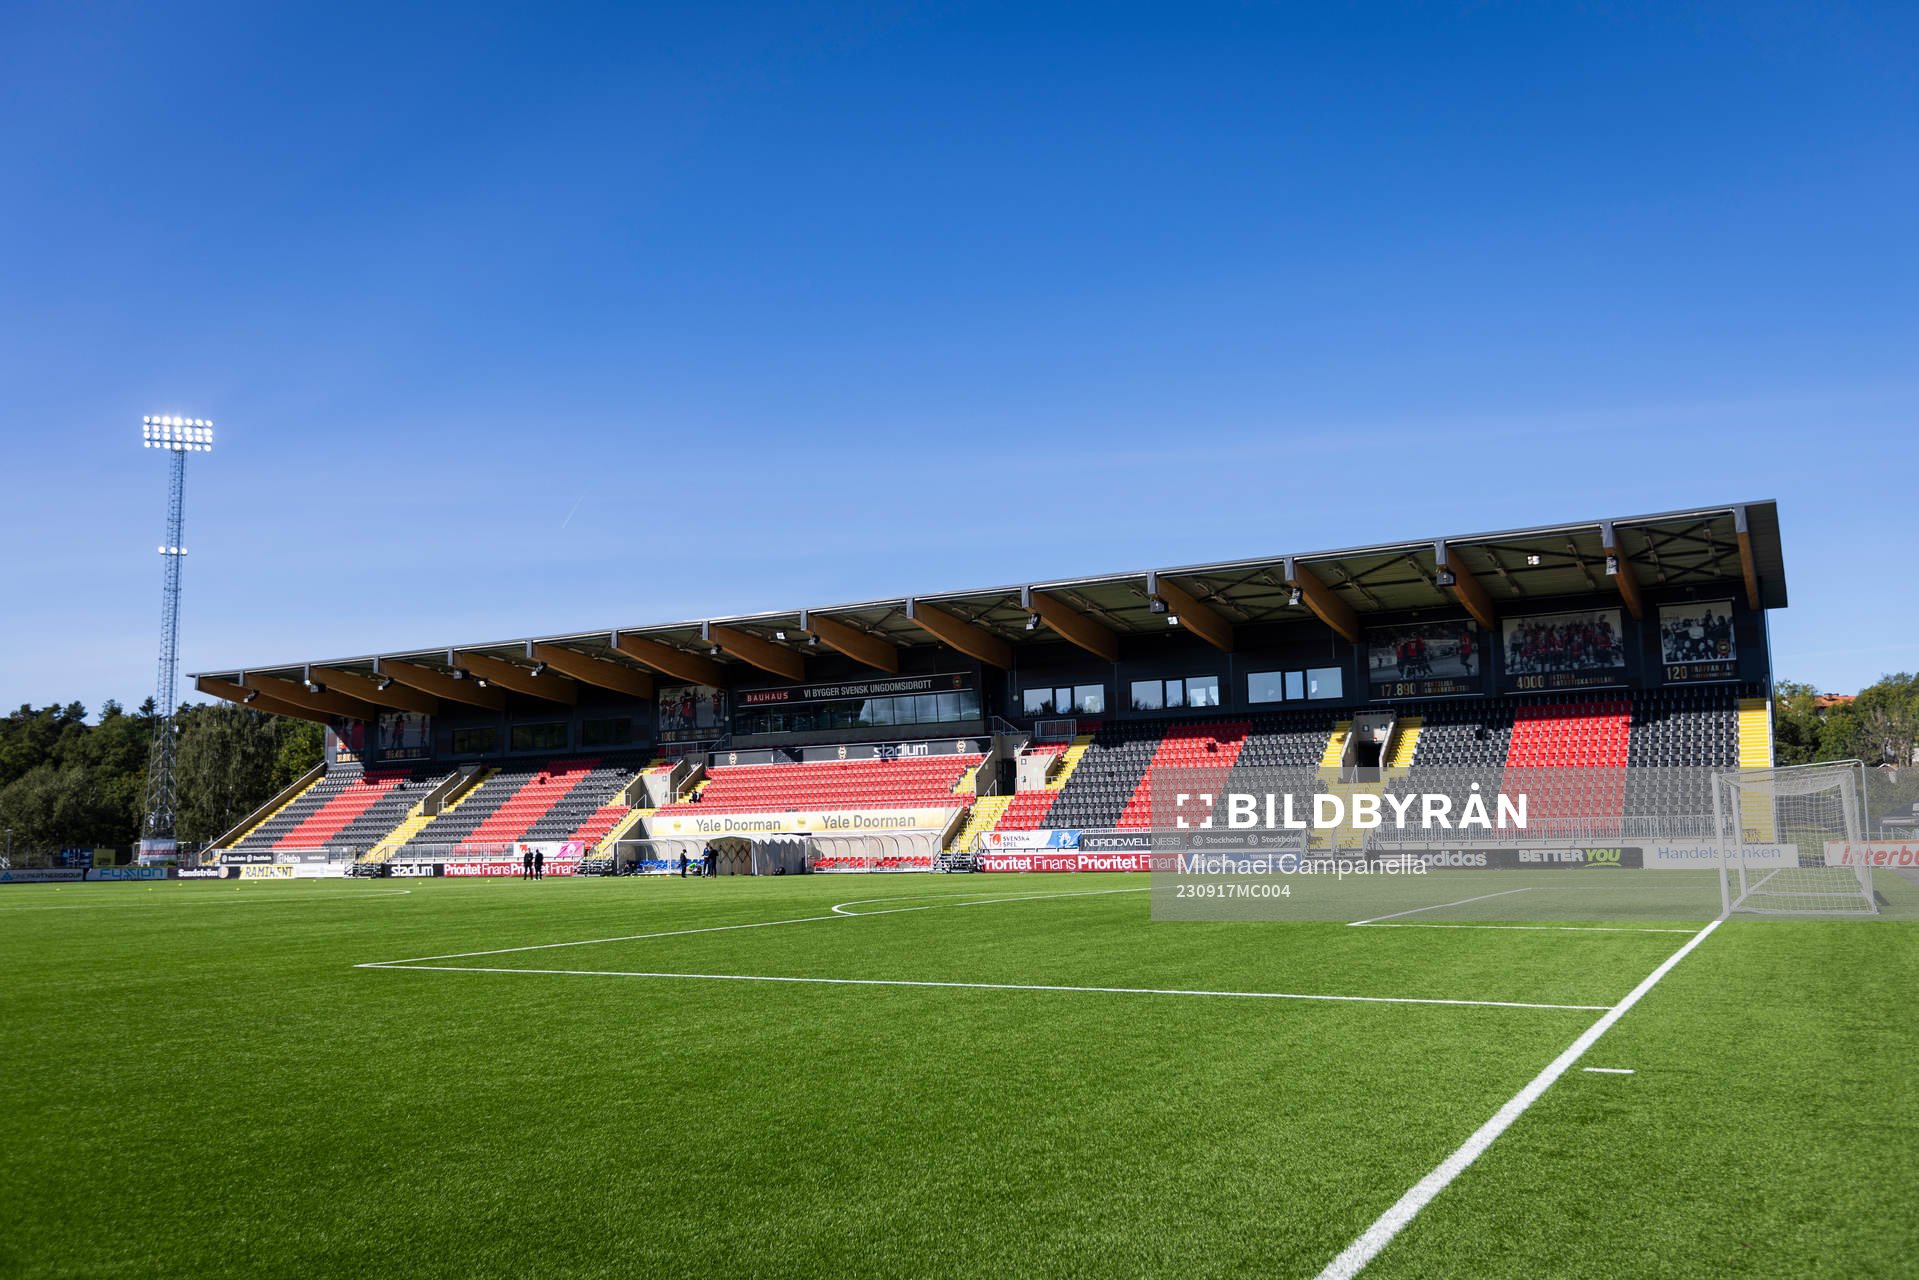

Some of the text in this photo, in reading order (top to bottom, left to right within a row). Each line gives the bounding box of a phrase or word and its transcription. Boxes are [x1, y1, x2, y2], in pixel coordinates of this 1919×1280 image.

[1666, 666, 1688, 680] 120
[804, 680, 932, 698] VI BYGGER SVENSK UNGDOMSIDROTT
[1516, 676, 1544, 689] 4000
[747, 691, 789, 702] BAUHAUS
[873, 743, 928, 757] stadium
[696, 817, 781, 832] Yale Doorman
[822, 814, 916, 829] Yale Doorman
[1206, 836, 1244, 844] Stockholm
[977, 856, 1031, 870] Prioritet
[1034, 856, 1076, 870] Finans
[1078, 855, 1137, 869] Prioritet
[1421, 851, 1487, 867] adidas
[1518, 849, 1621, 863] BETTER YOU
[391, 863, 433, 876] stadium
[444, 863, 481, 875] Prioritet
[482, 863, 510, 875] Finans
